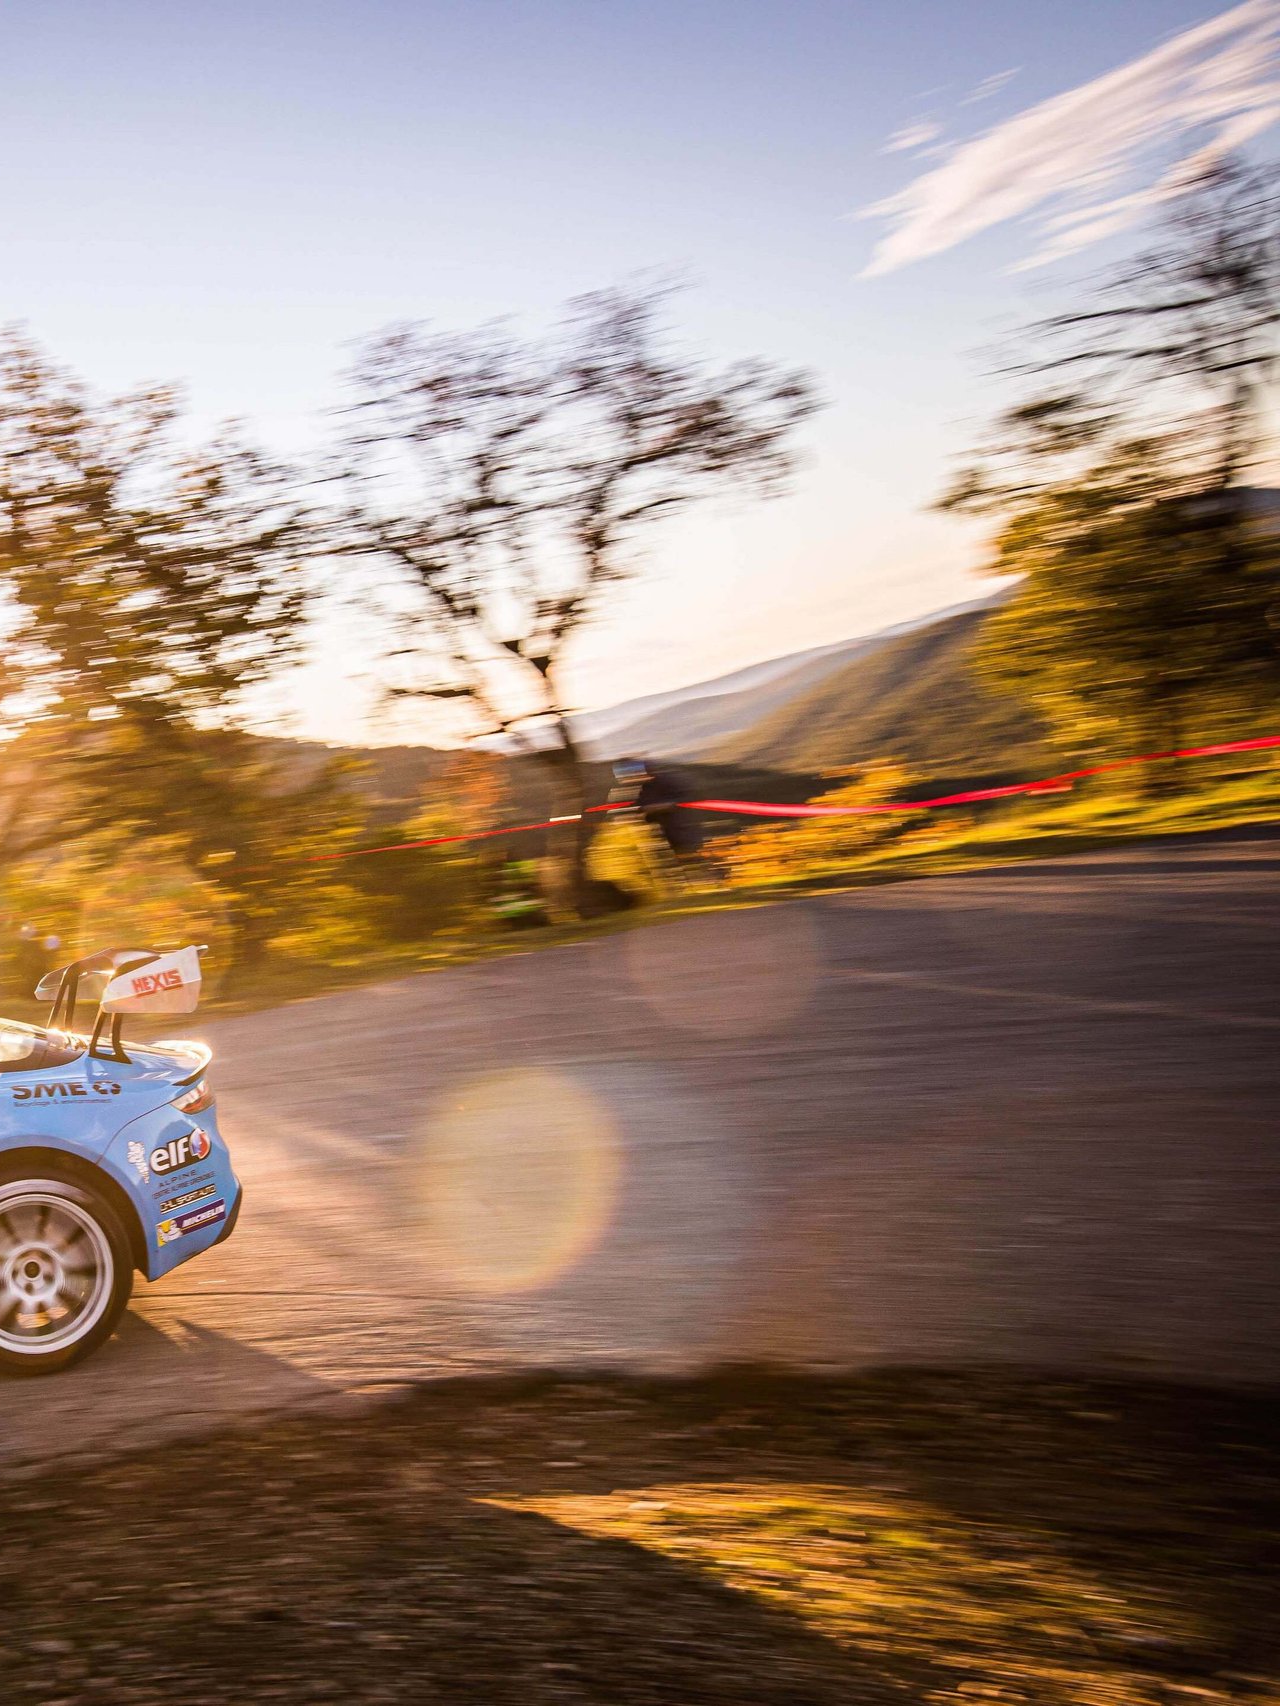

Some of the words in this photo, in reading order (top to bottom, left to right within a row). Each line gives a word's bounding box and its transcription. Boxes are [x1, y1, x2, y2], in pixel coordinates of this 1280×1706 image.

[132, 968, 183, 997] HEXIS
[11, 1082, 87, 1100] SME
[150, 1137, 189, 1172] elf
[159, 1169, 197, 1188] ALPINE
[181, 1203, 226, 1228] MICHELIN
